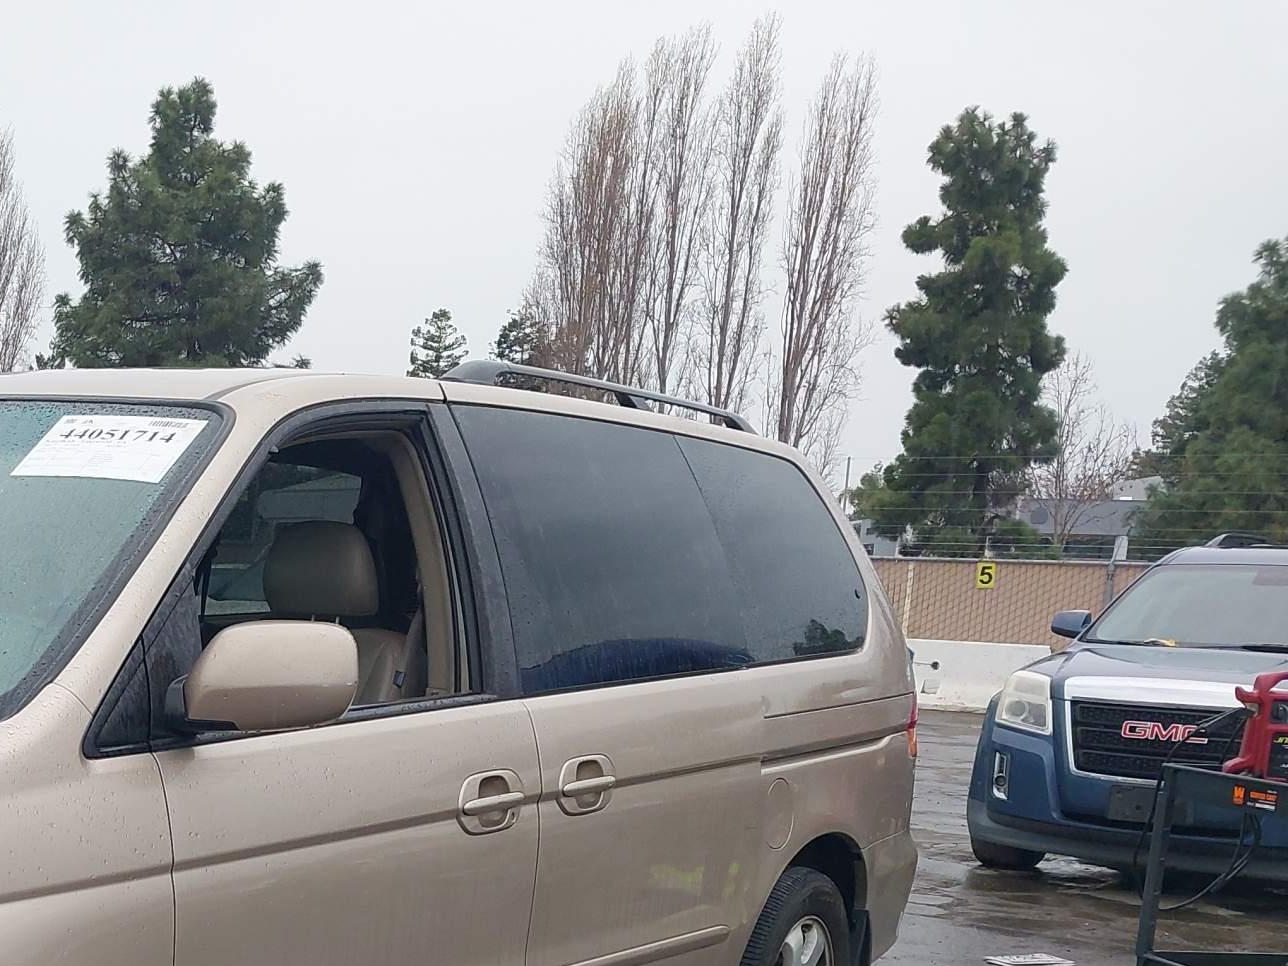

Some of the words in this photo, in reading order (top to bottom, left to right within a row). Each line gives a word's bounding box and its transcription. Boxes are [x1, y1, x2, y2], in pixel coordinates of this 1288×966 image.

[60, 428, 177, 443] 44051714
[979, 566, 993, 584] 5
[1121, 720, 1209, 744] GMC
